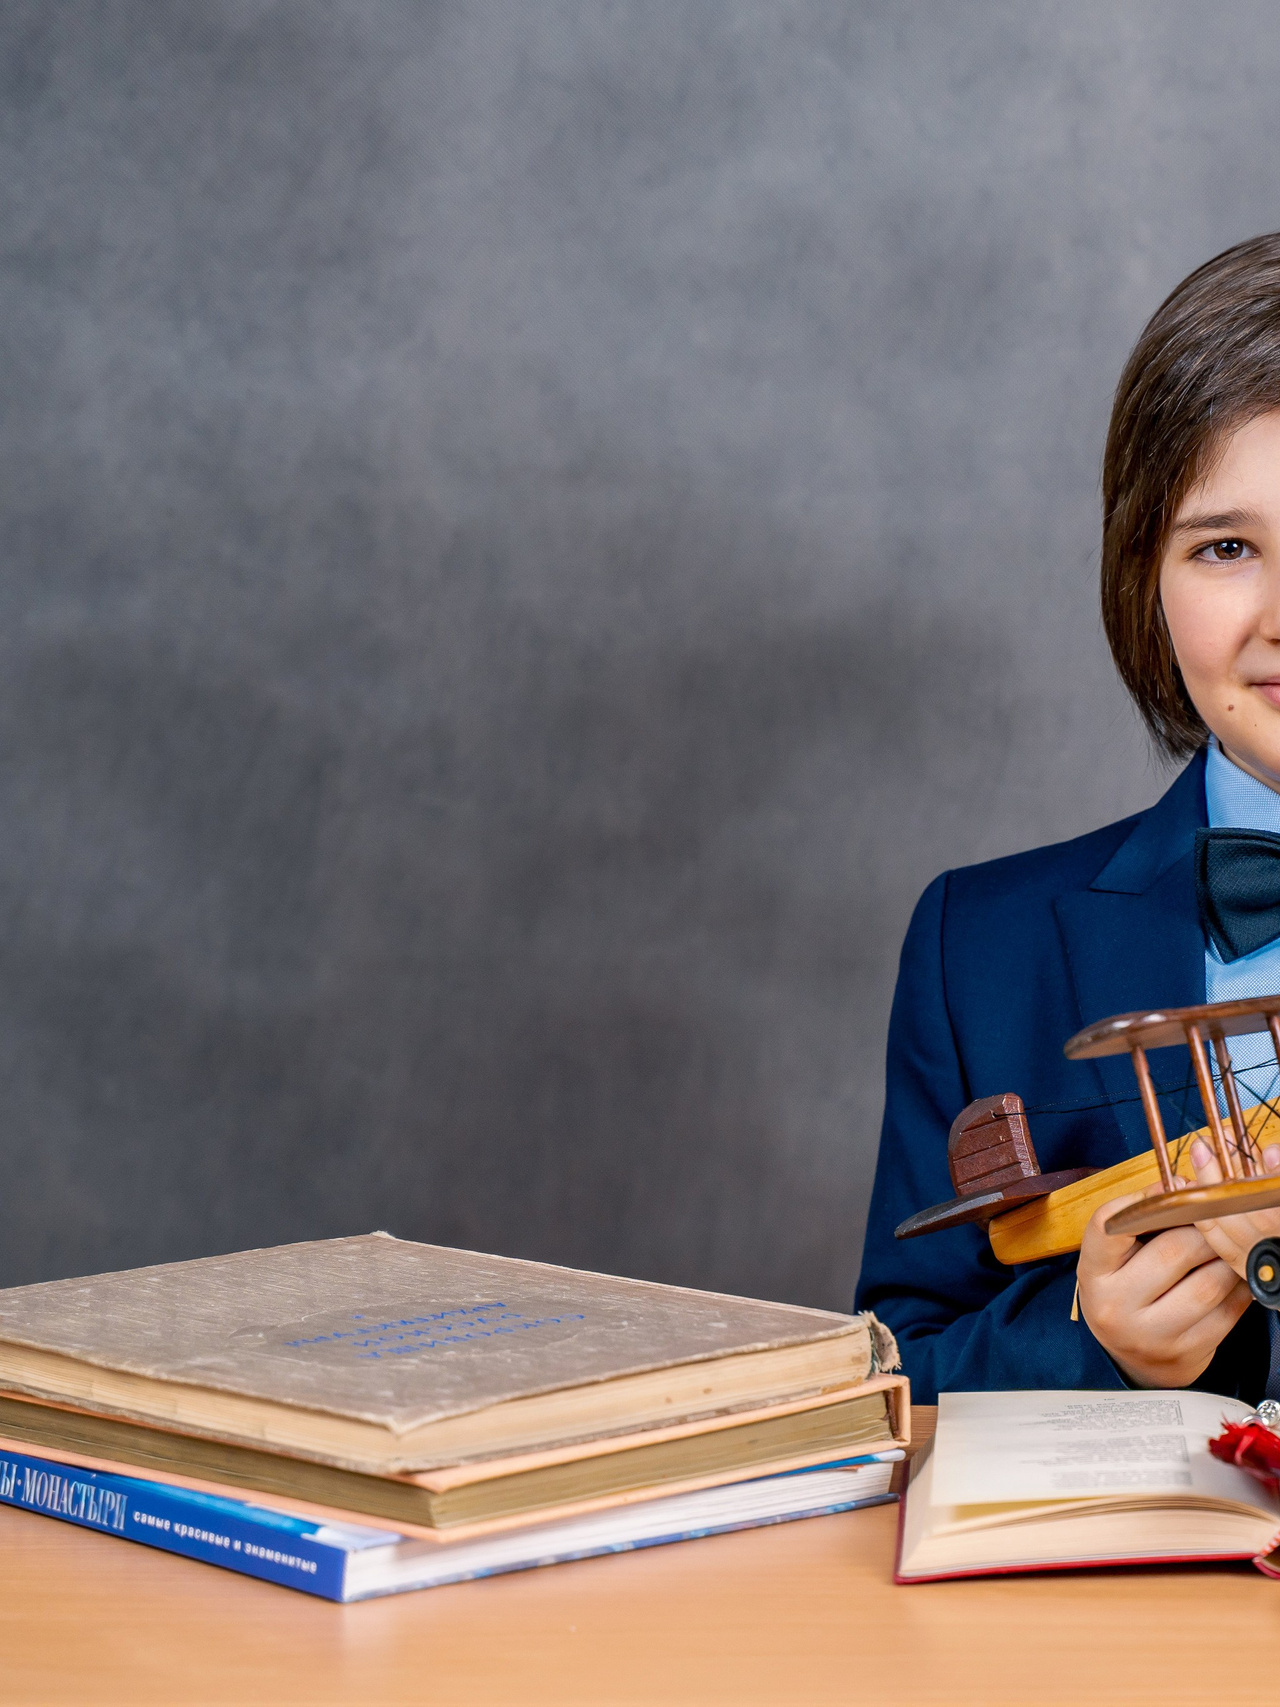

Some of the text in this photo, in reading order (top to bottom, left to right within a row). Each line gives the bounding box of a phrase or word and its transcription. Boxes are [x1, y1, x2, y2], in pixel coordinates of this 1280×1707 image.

[132, 1511, 318, 1575] самые красивые и знаменитые
